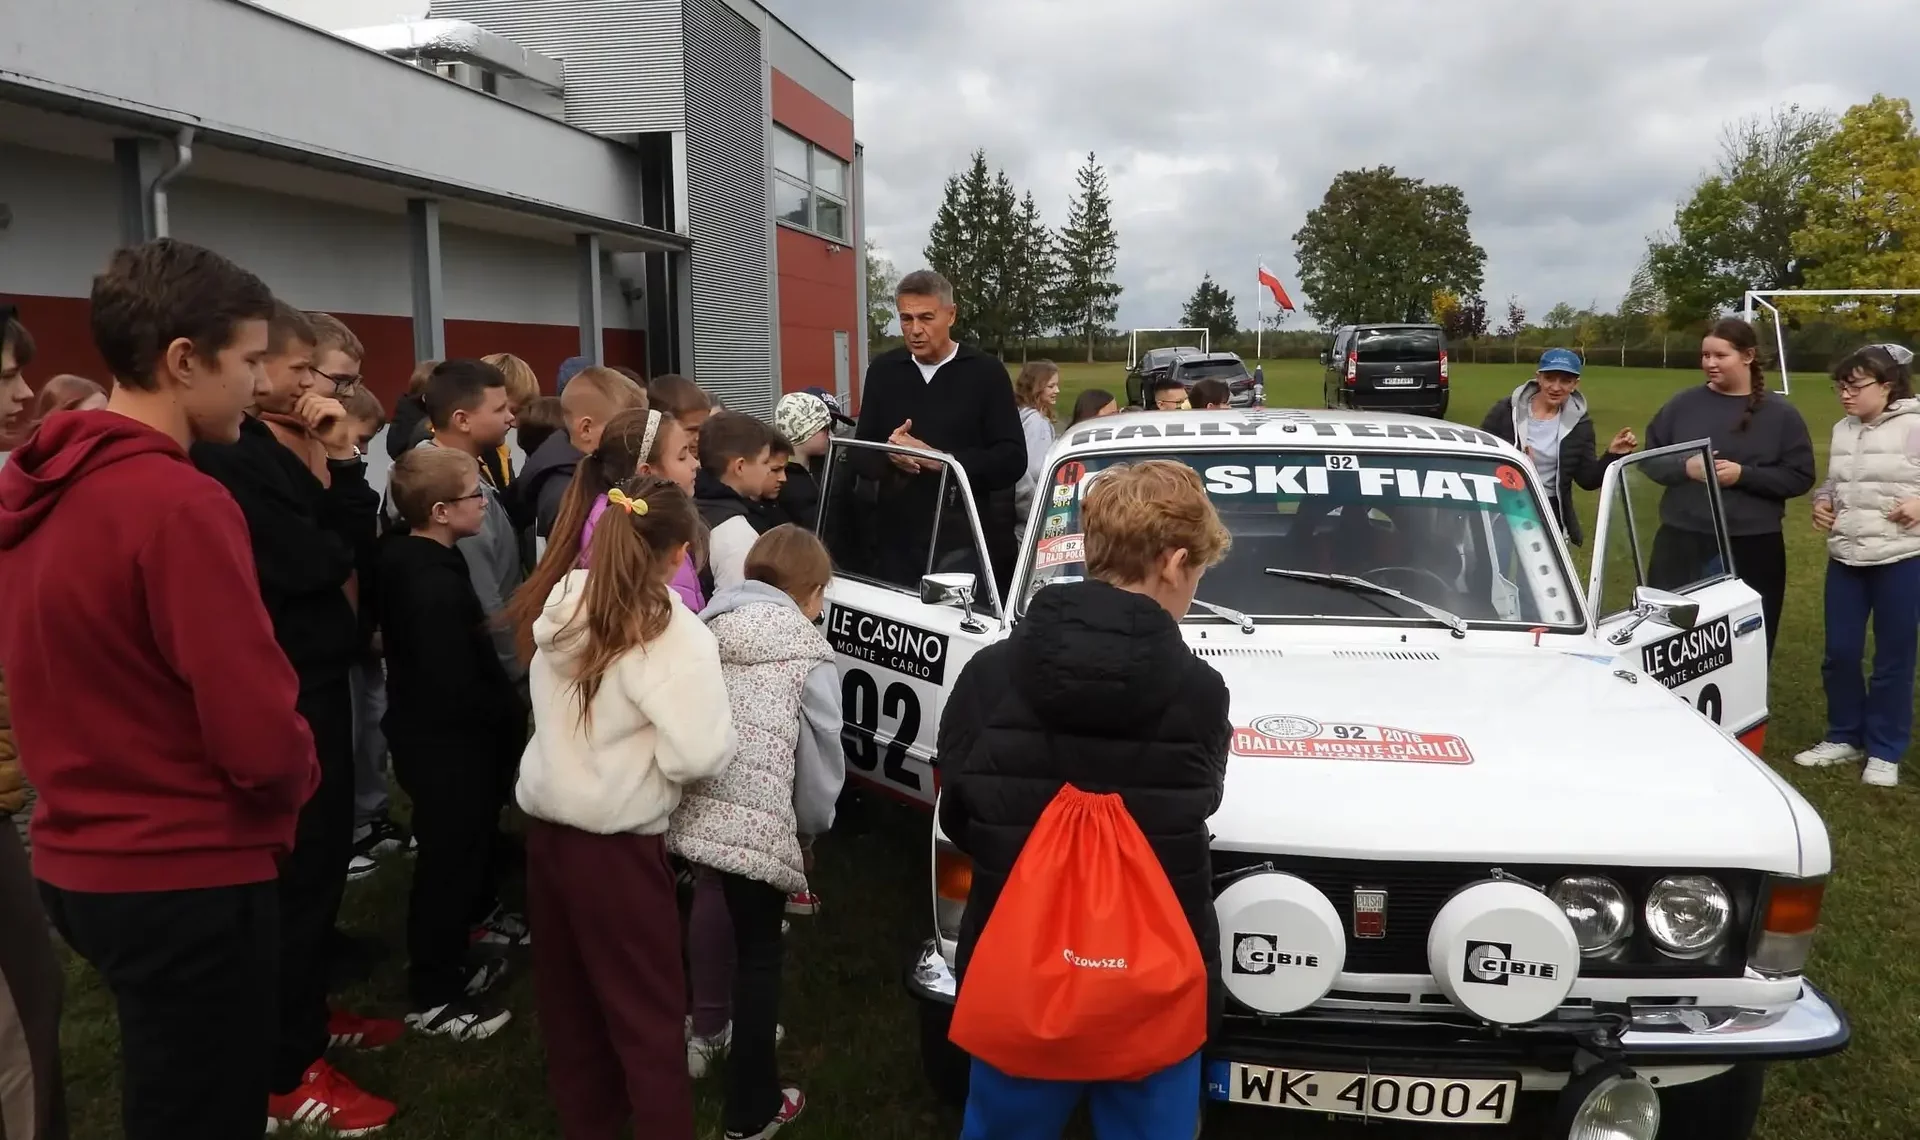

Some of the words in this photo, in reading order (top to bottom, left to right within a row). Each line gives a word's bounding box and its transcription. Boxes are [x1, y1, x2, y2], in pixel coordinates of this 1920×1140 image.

[1071, 422, 1262, 446] RALLY
[1304, 422, 1500, 447] TEAM
[1064, 464, 1079, 483] H
[1330, 456, 1353, 470] 92
[1358, 466, 1503, 504] FIAT
[1066, 542, 1076, 550] 92
[831, 607, 852, 636] LE
[857, 616, 942, 663] CASINO
[837, 640, 876, 661] MONTE
[891, 656, 930, 678] CARLO
[1645, 646, 1665, 676] LE
[1668, 621, 1727, 666] CASINO
[1697, 653, 1725, 674] CARLO
[841, 668, 921, 791] 92
[1333, 726, 1367, 739] 92
[1382, 729, 1423, 744] 2016
[1236, 732, 1306, 752] RALLYE
[1313, 739, 1463, 758] MONTE-CARLO
[1208, 1082, 1226, 1094] PL
[1240, 1065, 1316, 1106] WK
[1336, 1076, 1508, 1119] 40004
